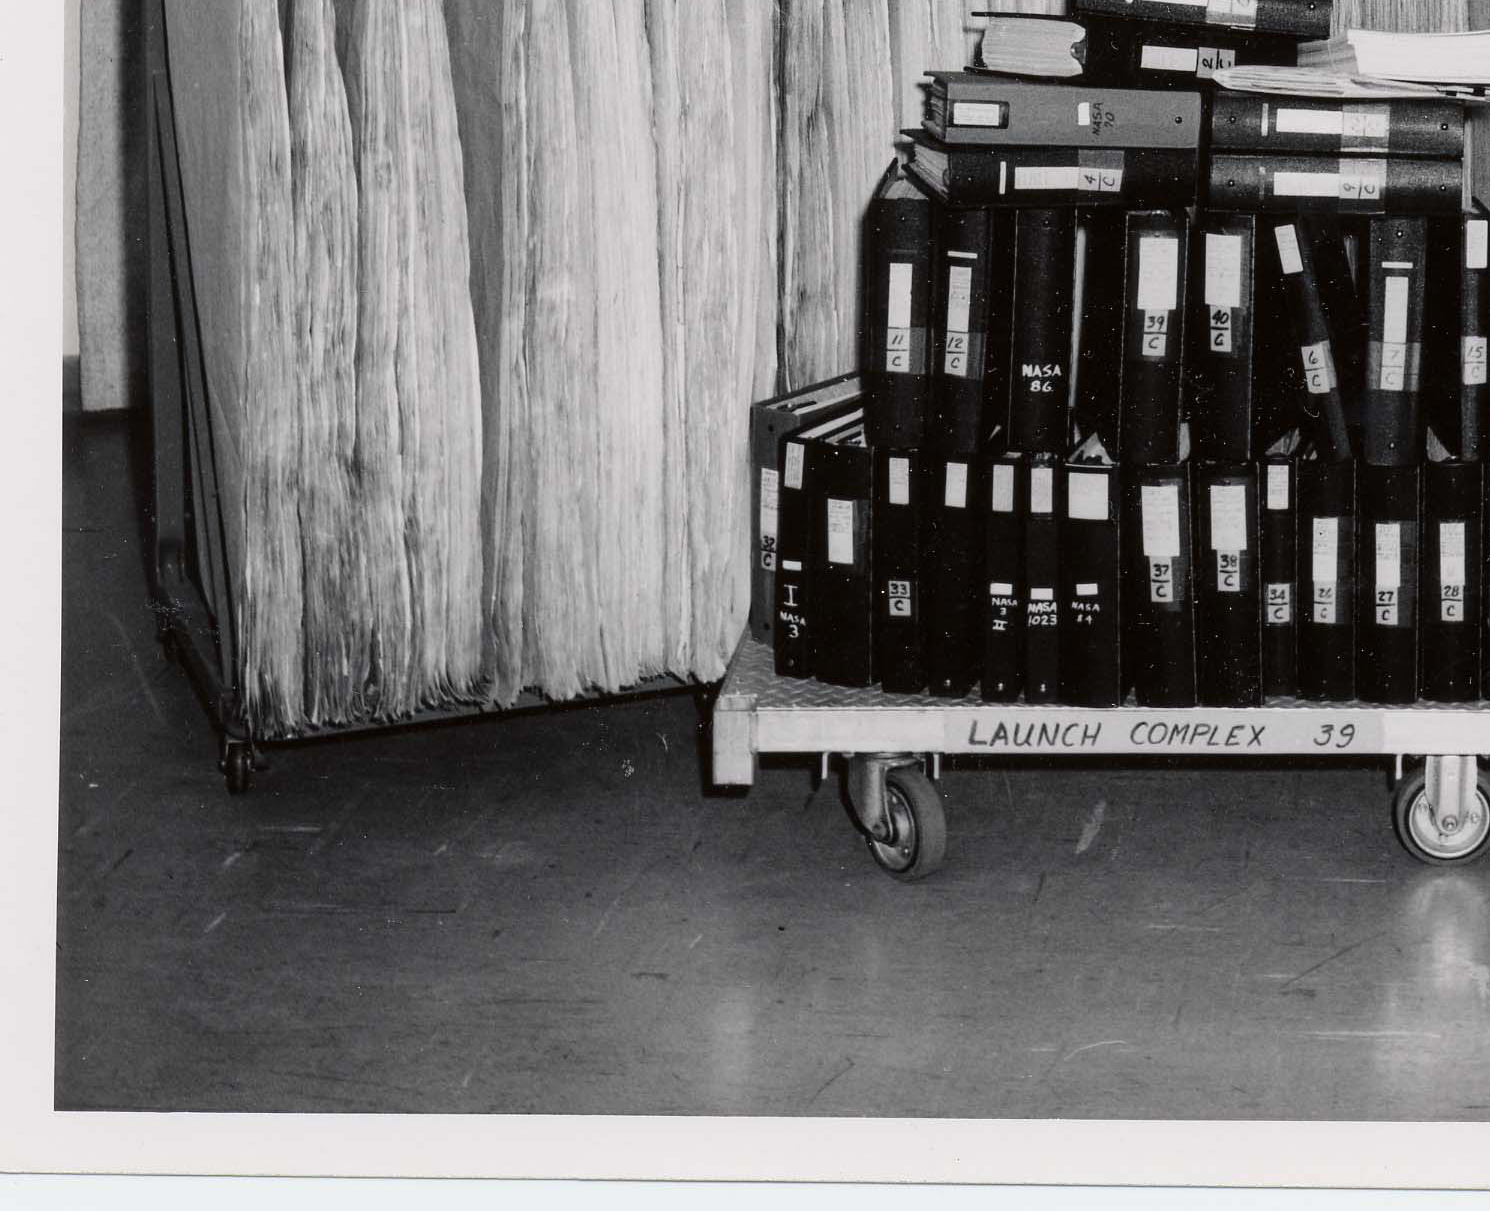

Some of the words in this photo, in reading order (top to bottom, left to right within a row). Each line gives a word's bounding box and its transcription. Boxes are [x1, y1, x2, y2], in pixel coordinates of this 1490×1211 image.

[1092, 102, 1103, 136] NASA
[1103, 177, 1114, 186] C
[1148, 316, 1164, 330] 39
[948, 337, 962, 348] 12
[1148, 337, 1159, 349] C
[1308, 350, 1318, 364] 6
[1467, 346, 1483, 358] 15
[892, 356, 901, 366] C
[951, 357, 960, 368] C
[1022, 364, 1061, 377] NASA
[1312, 374, 1320, 387] C
[1385, 371, 1397, 385] C
[763, 554, 771, 566] C
[1153, 564, 1169, 577] 37
[1224, 575, 1233, 586] C
[784, 585, 797, 606] I
[1156, 585, 1166, 597] C
[1378, 591, 1394, 602] 27
[1444, 586, 1459, 597] 28
[895, 601, 905, 611] C
[991, 597, 1018, 606] NASA
[1071, 602, 1100, 612] NASA
[1027, 602, 1057, 614] NASA
[1274, 608, 1284, 619] C
[1447, 605, 1455, 617] C
[780, 611, 805, 625] NASA
[1028, 615, 1058, 627] 1023
[1381, 610, 1390, 621] C
[789, 625, 798, 637] 3
[969, 721, 1101, 746] LAUNCH
[1130, 722, 1265, 746] COMPLEX
[1314, 724, 1355, 748] 39
